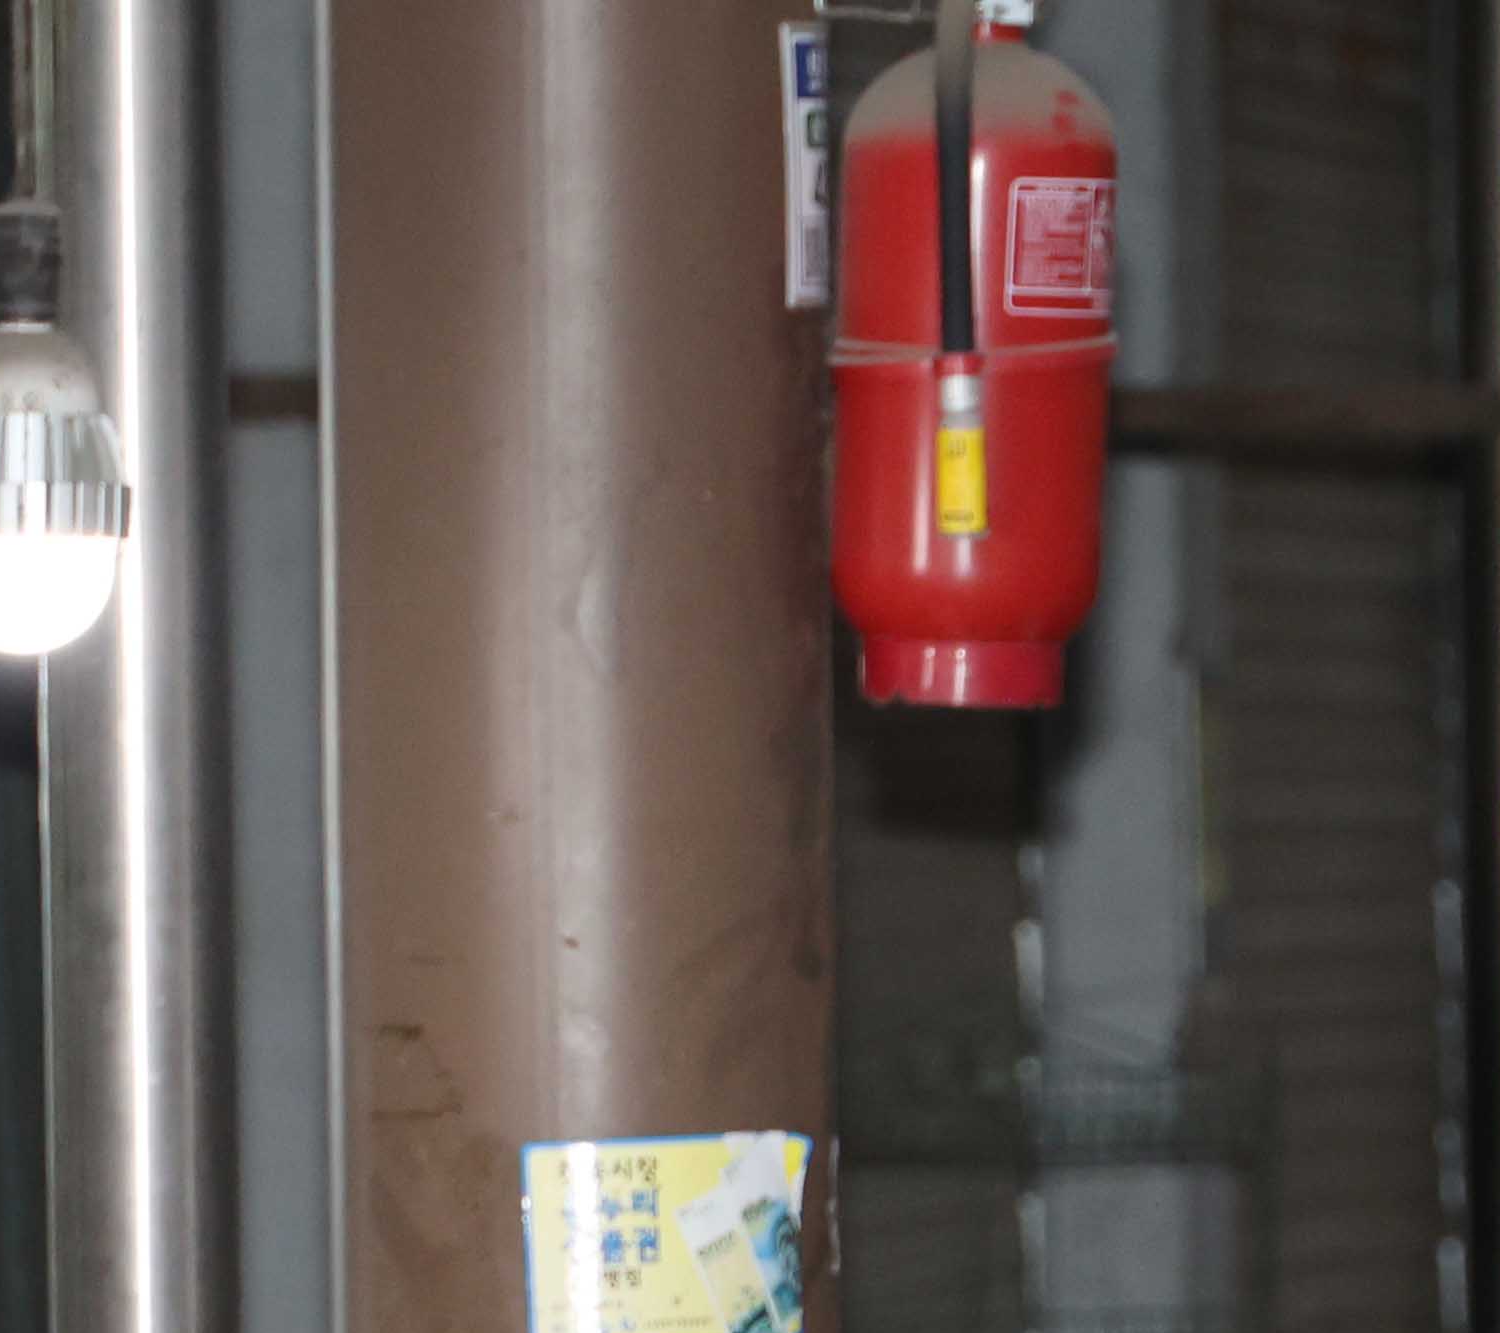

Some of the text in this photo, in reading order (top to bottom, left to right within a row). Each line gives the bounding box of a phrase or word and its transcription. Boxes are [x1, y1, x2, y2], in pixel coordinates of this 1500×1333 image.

[559, 1156, 658, 1182] 시장
[562, 1188, 660, 1219] 누리
[563, 1226, 661, 1264] 품권
